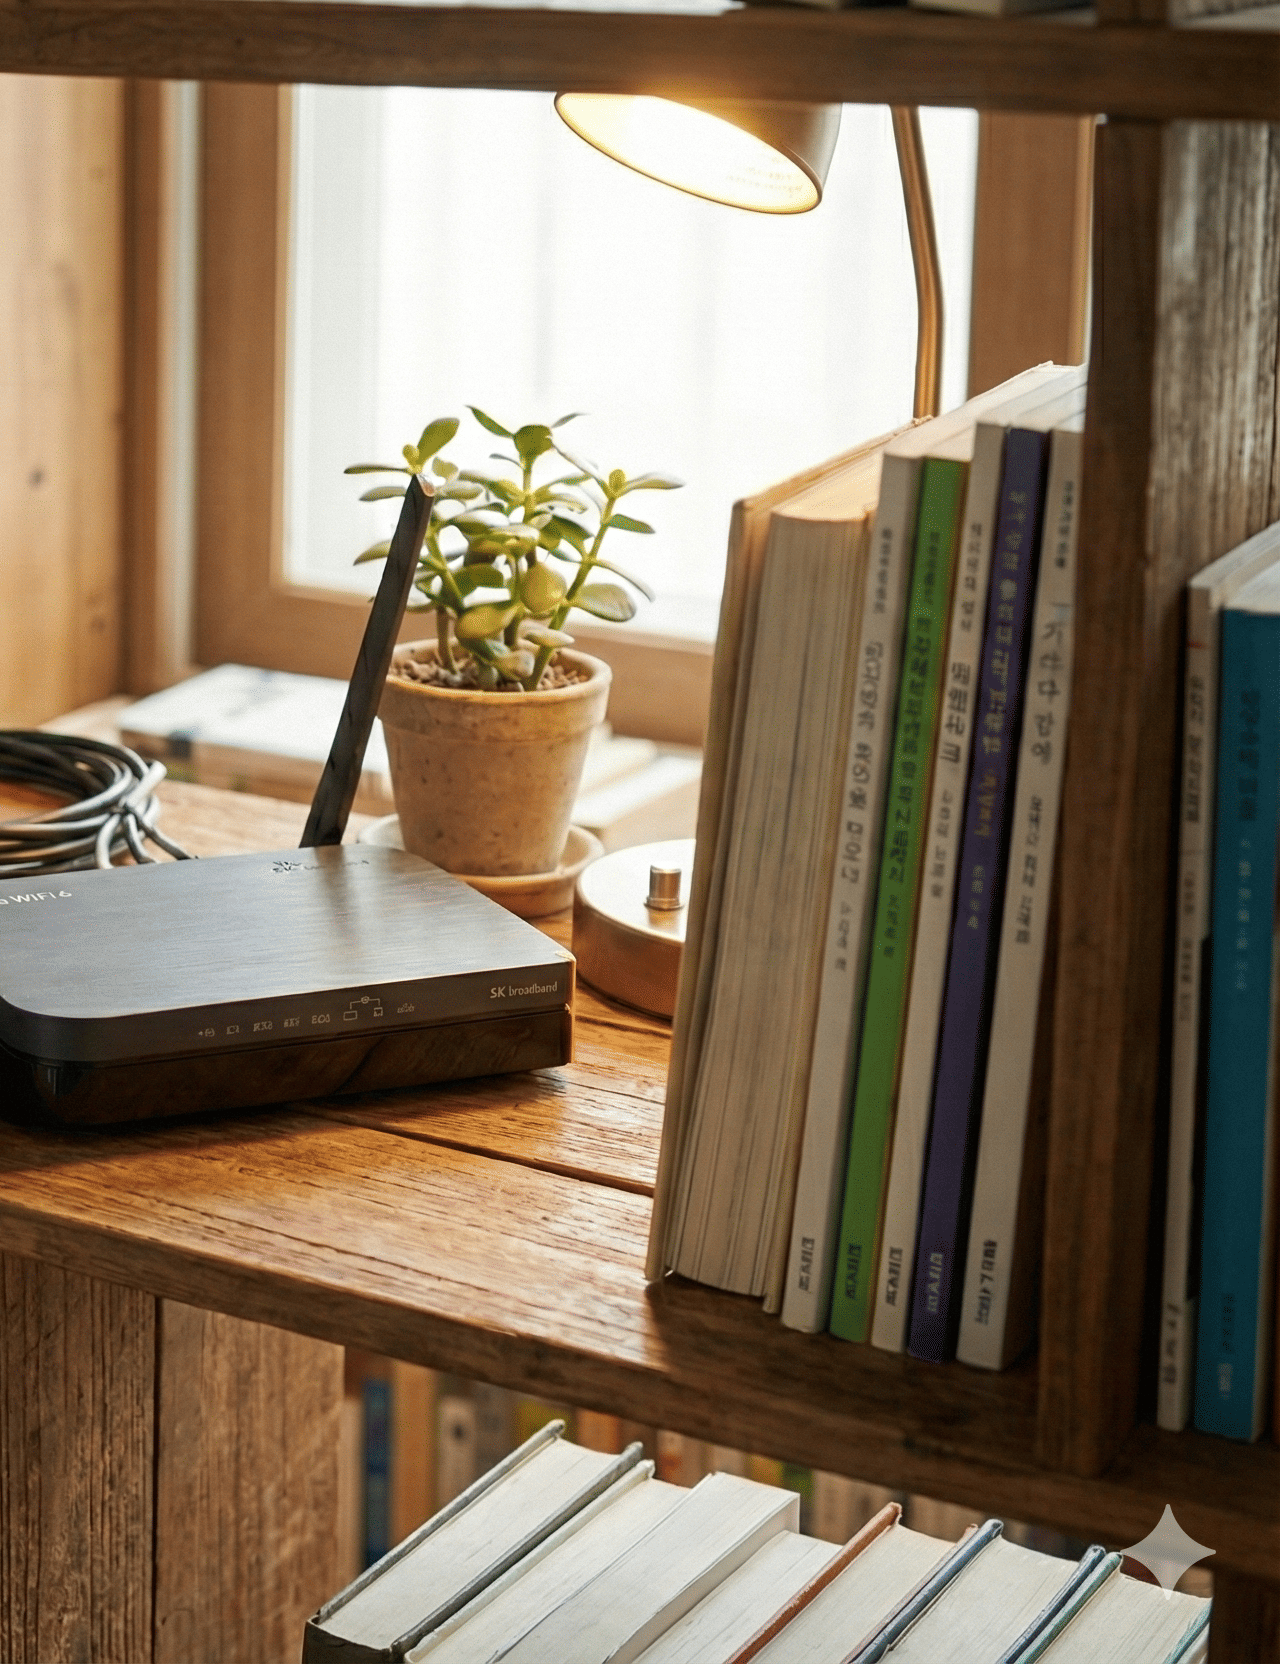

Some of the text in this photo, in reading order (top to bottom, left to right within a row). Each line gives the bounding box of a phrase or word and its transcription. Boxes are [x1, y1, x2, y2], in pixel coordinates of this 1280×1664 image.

[59, 890, 73, 898] 6
[489, 981, 558, 999] SK broadband
